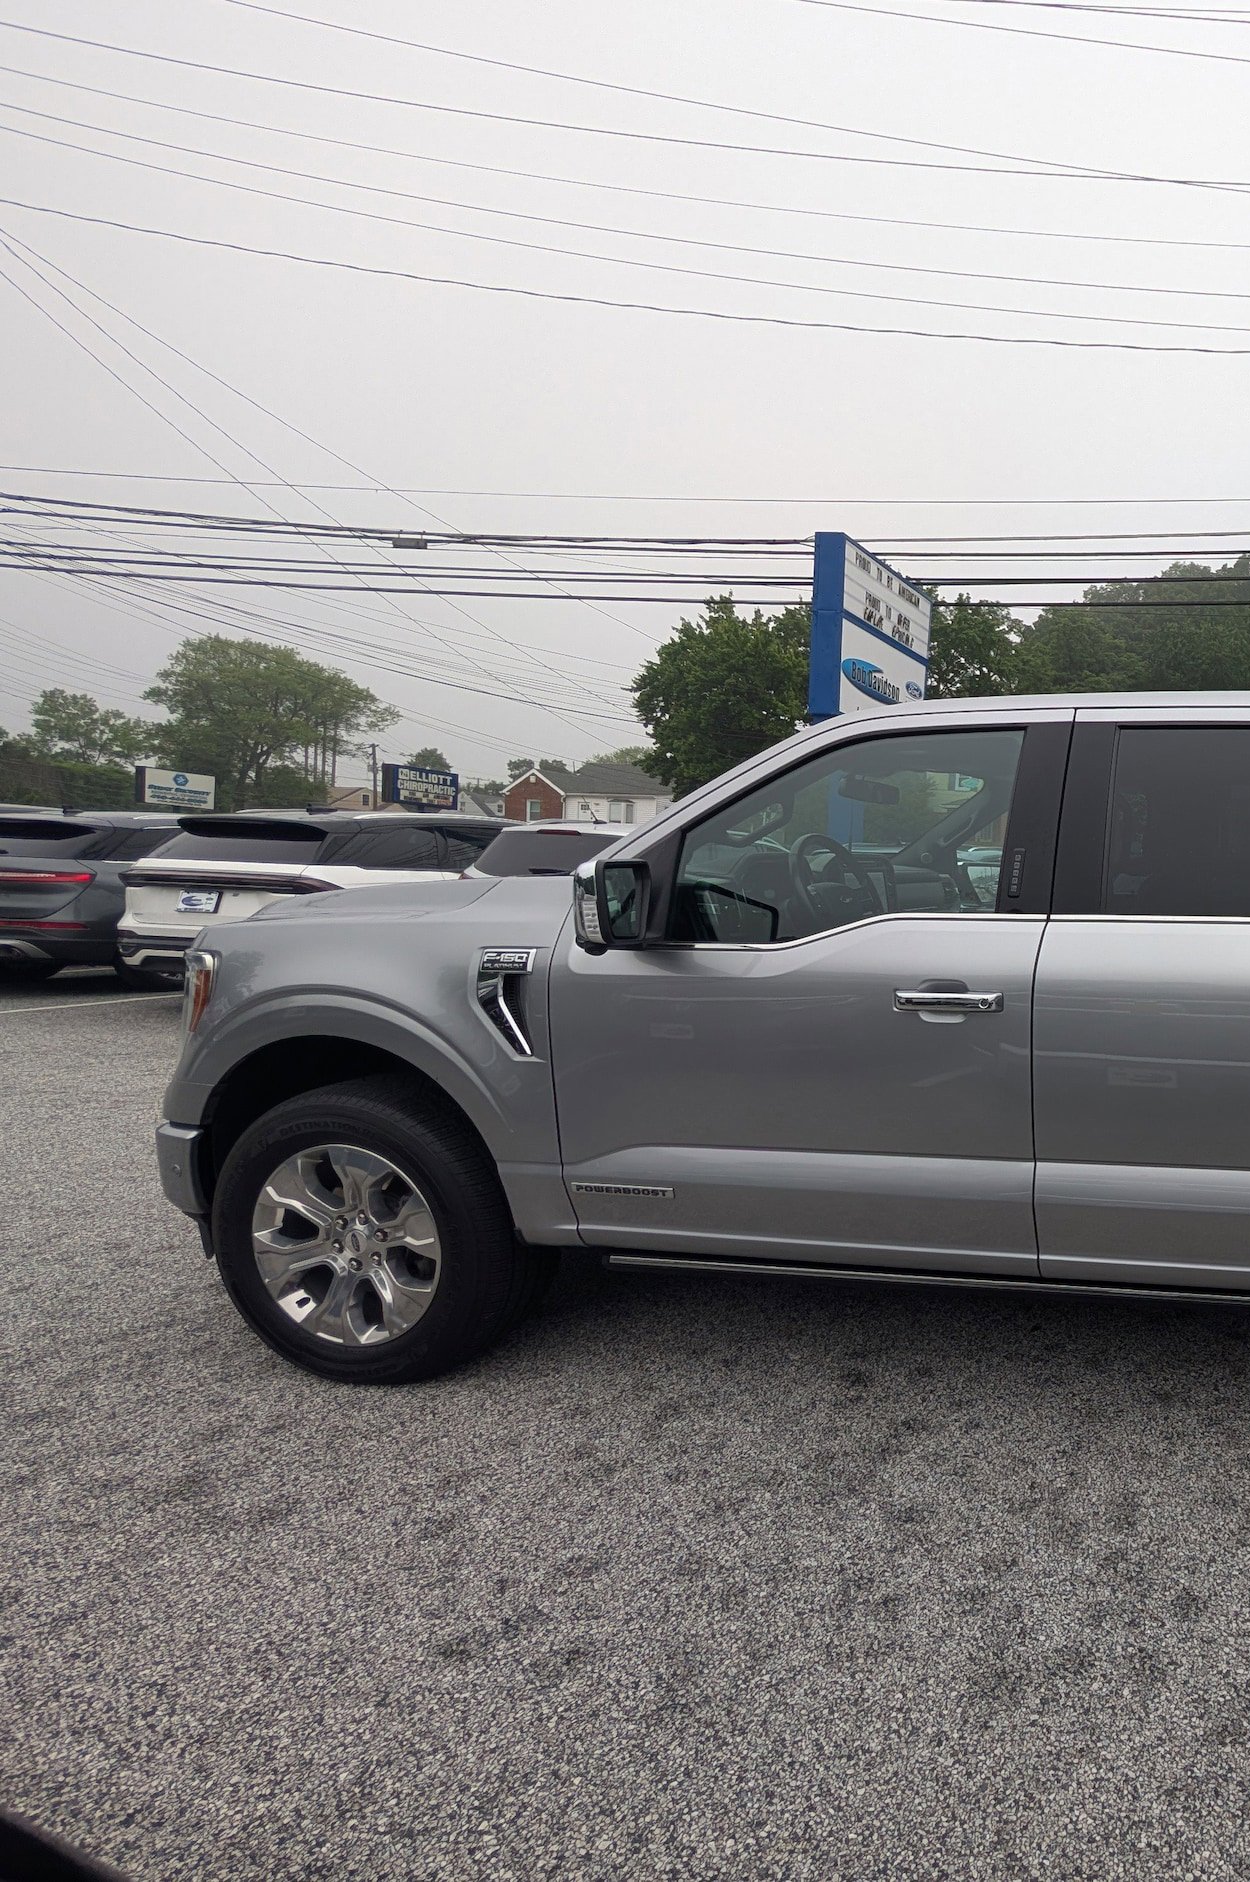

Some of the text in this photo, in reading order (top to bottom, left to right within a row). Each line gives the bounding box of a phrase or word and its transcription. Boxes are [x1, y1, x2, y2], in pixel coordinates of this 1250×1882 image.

[876, 567, 883, 584] TO
[851, 661, 900, 702] Bob Davidson
[410, 770, 453, 785] ELLIOTT
[397, 779, 456, 796] CHIROPRACTIC
[483, 953, 528, 962] F-150
[575, 1184, 667, 1197] POWERBOOST
